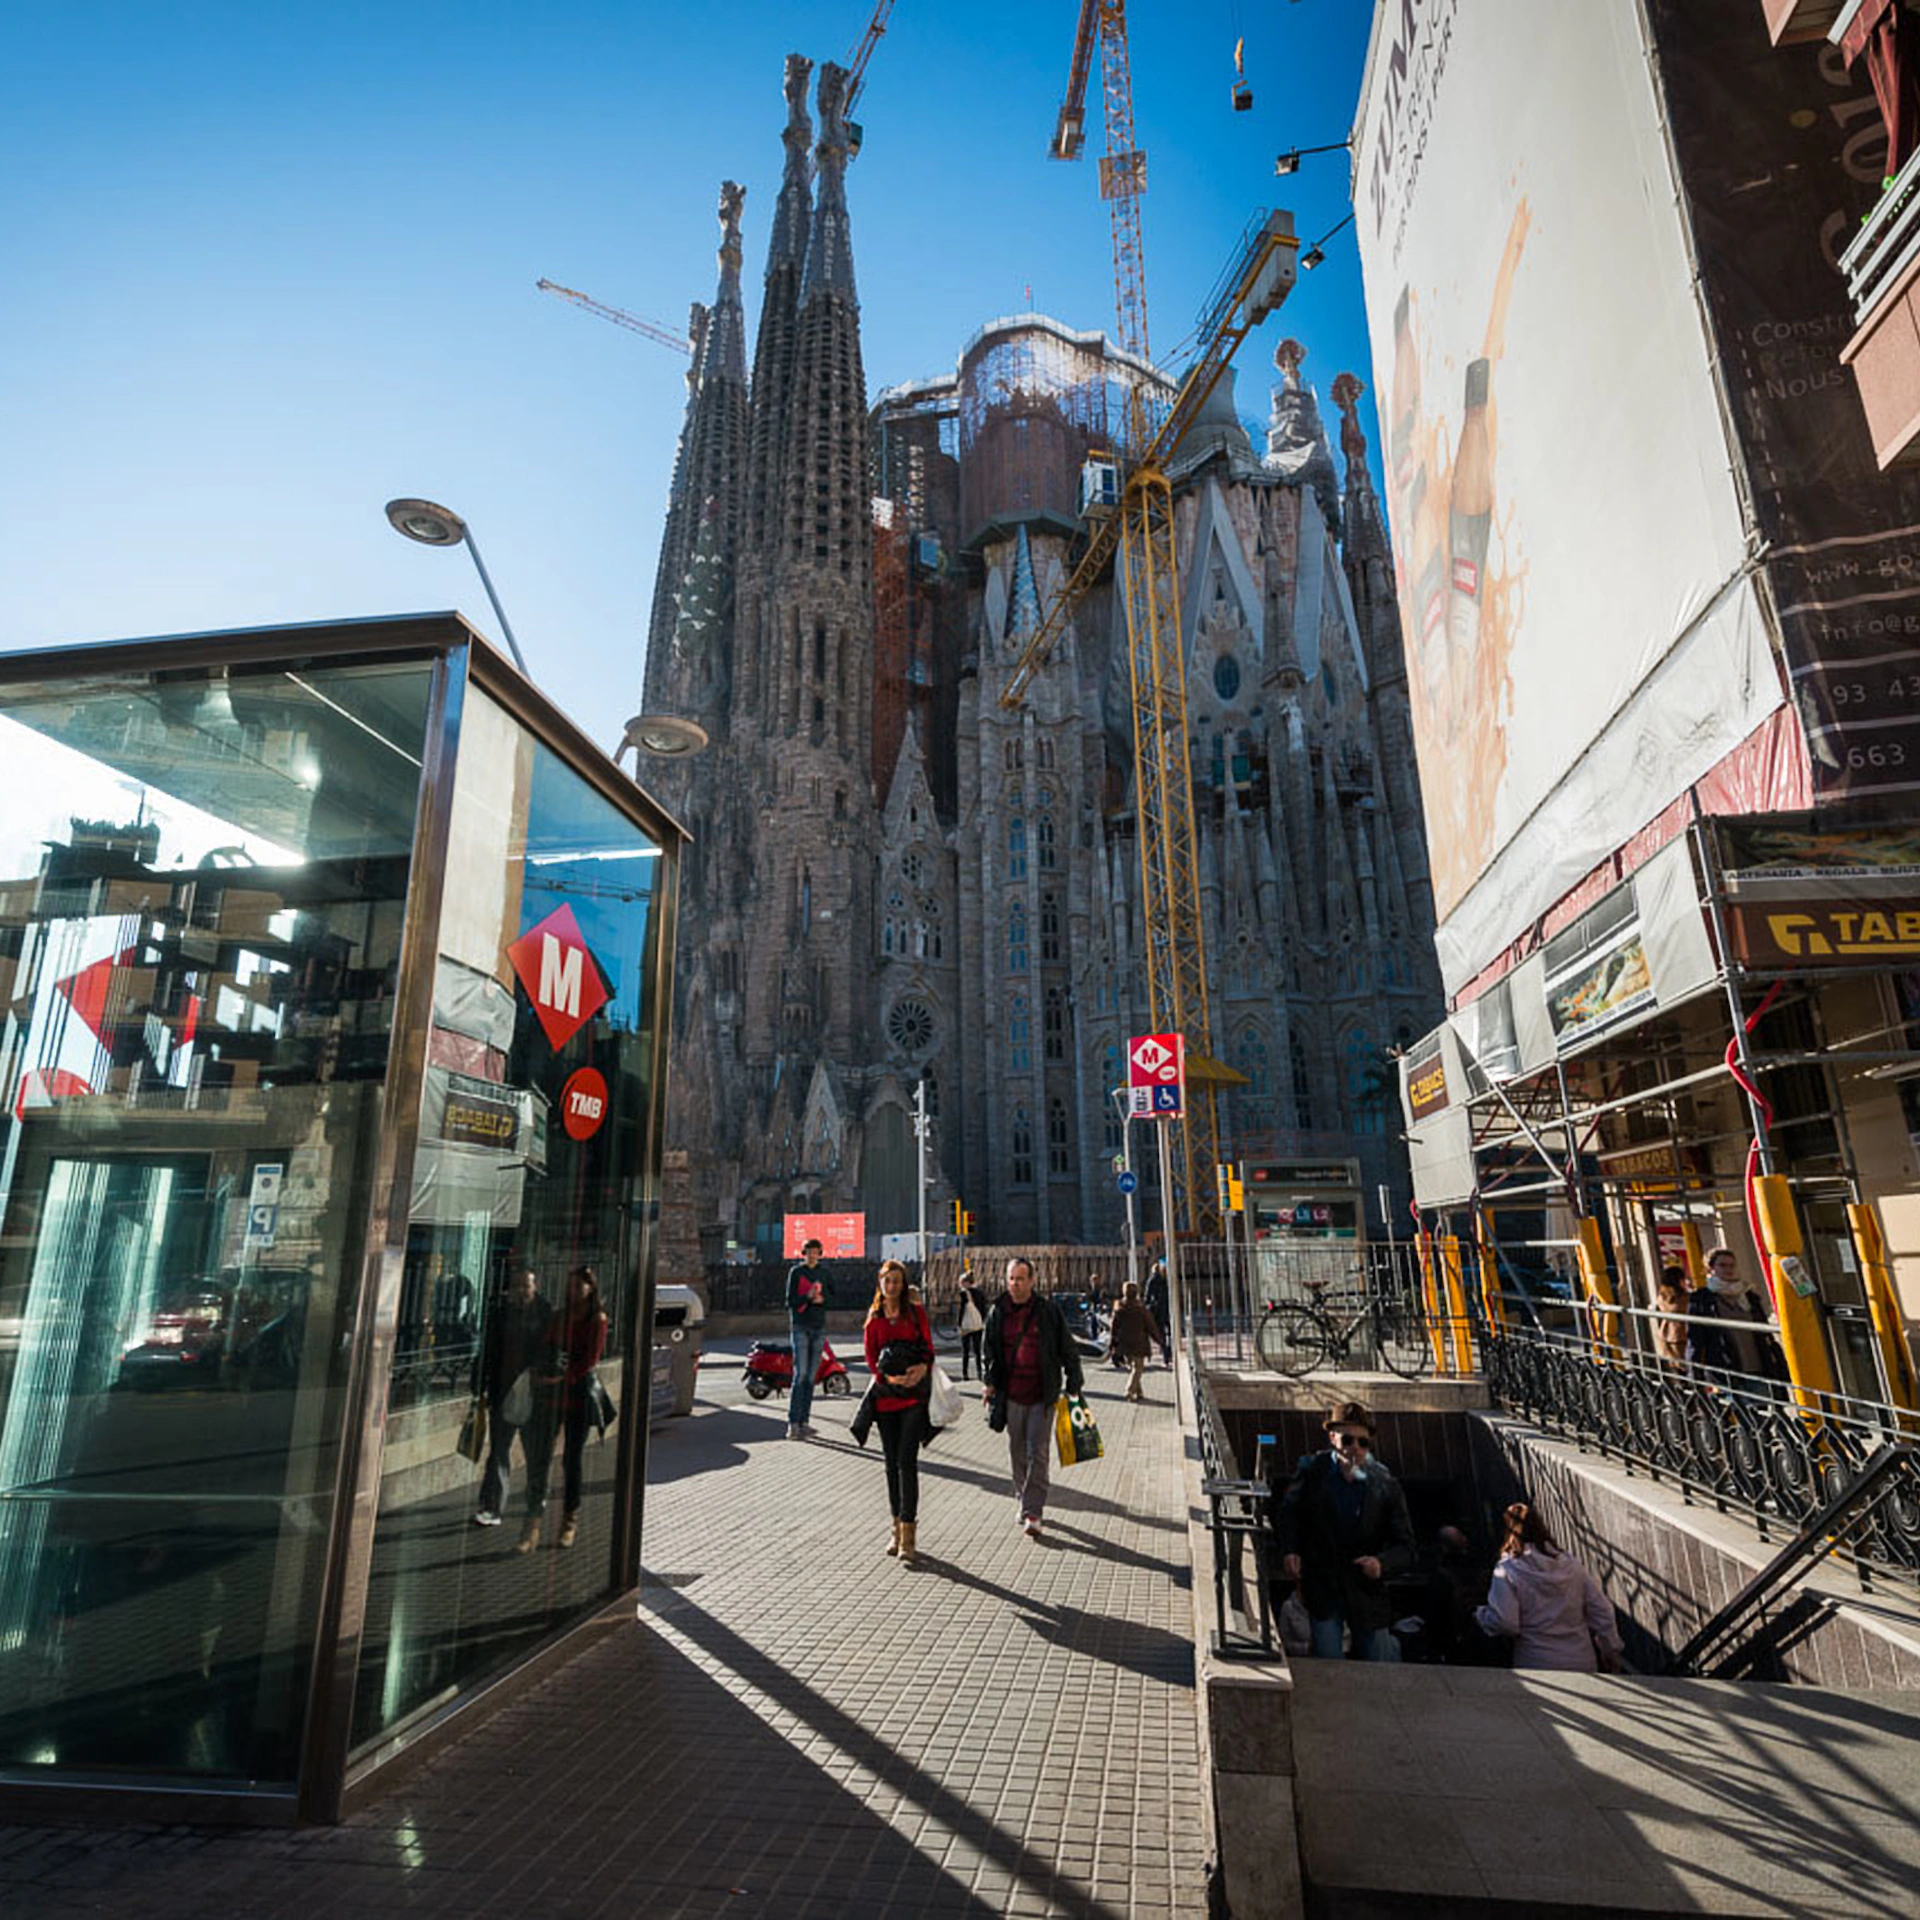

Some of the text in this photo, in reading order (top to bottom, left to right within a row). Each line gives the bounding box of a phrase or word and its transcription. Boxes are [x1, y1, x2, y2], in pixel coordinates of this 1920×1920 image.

[1371, 0, 1421, 240] ZUM
[1765, 367, 1845, 400] Nous
[1833, 684, 1866, 704] 93
[1849, 744, 1905, 768] 663
[1829, 911, 1920, 942] TAB
[538, 931, 583, 1018] M
[1142, 1047, 1158, 1066] M
[571, 1091, 603, 1119] TMB
